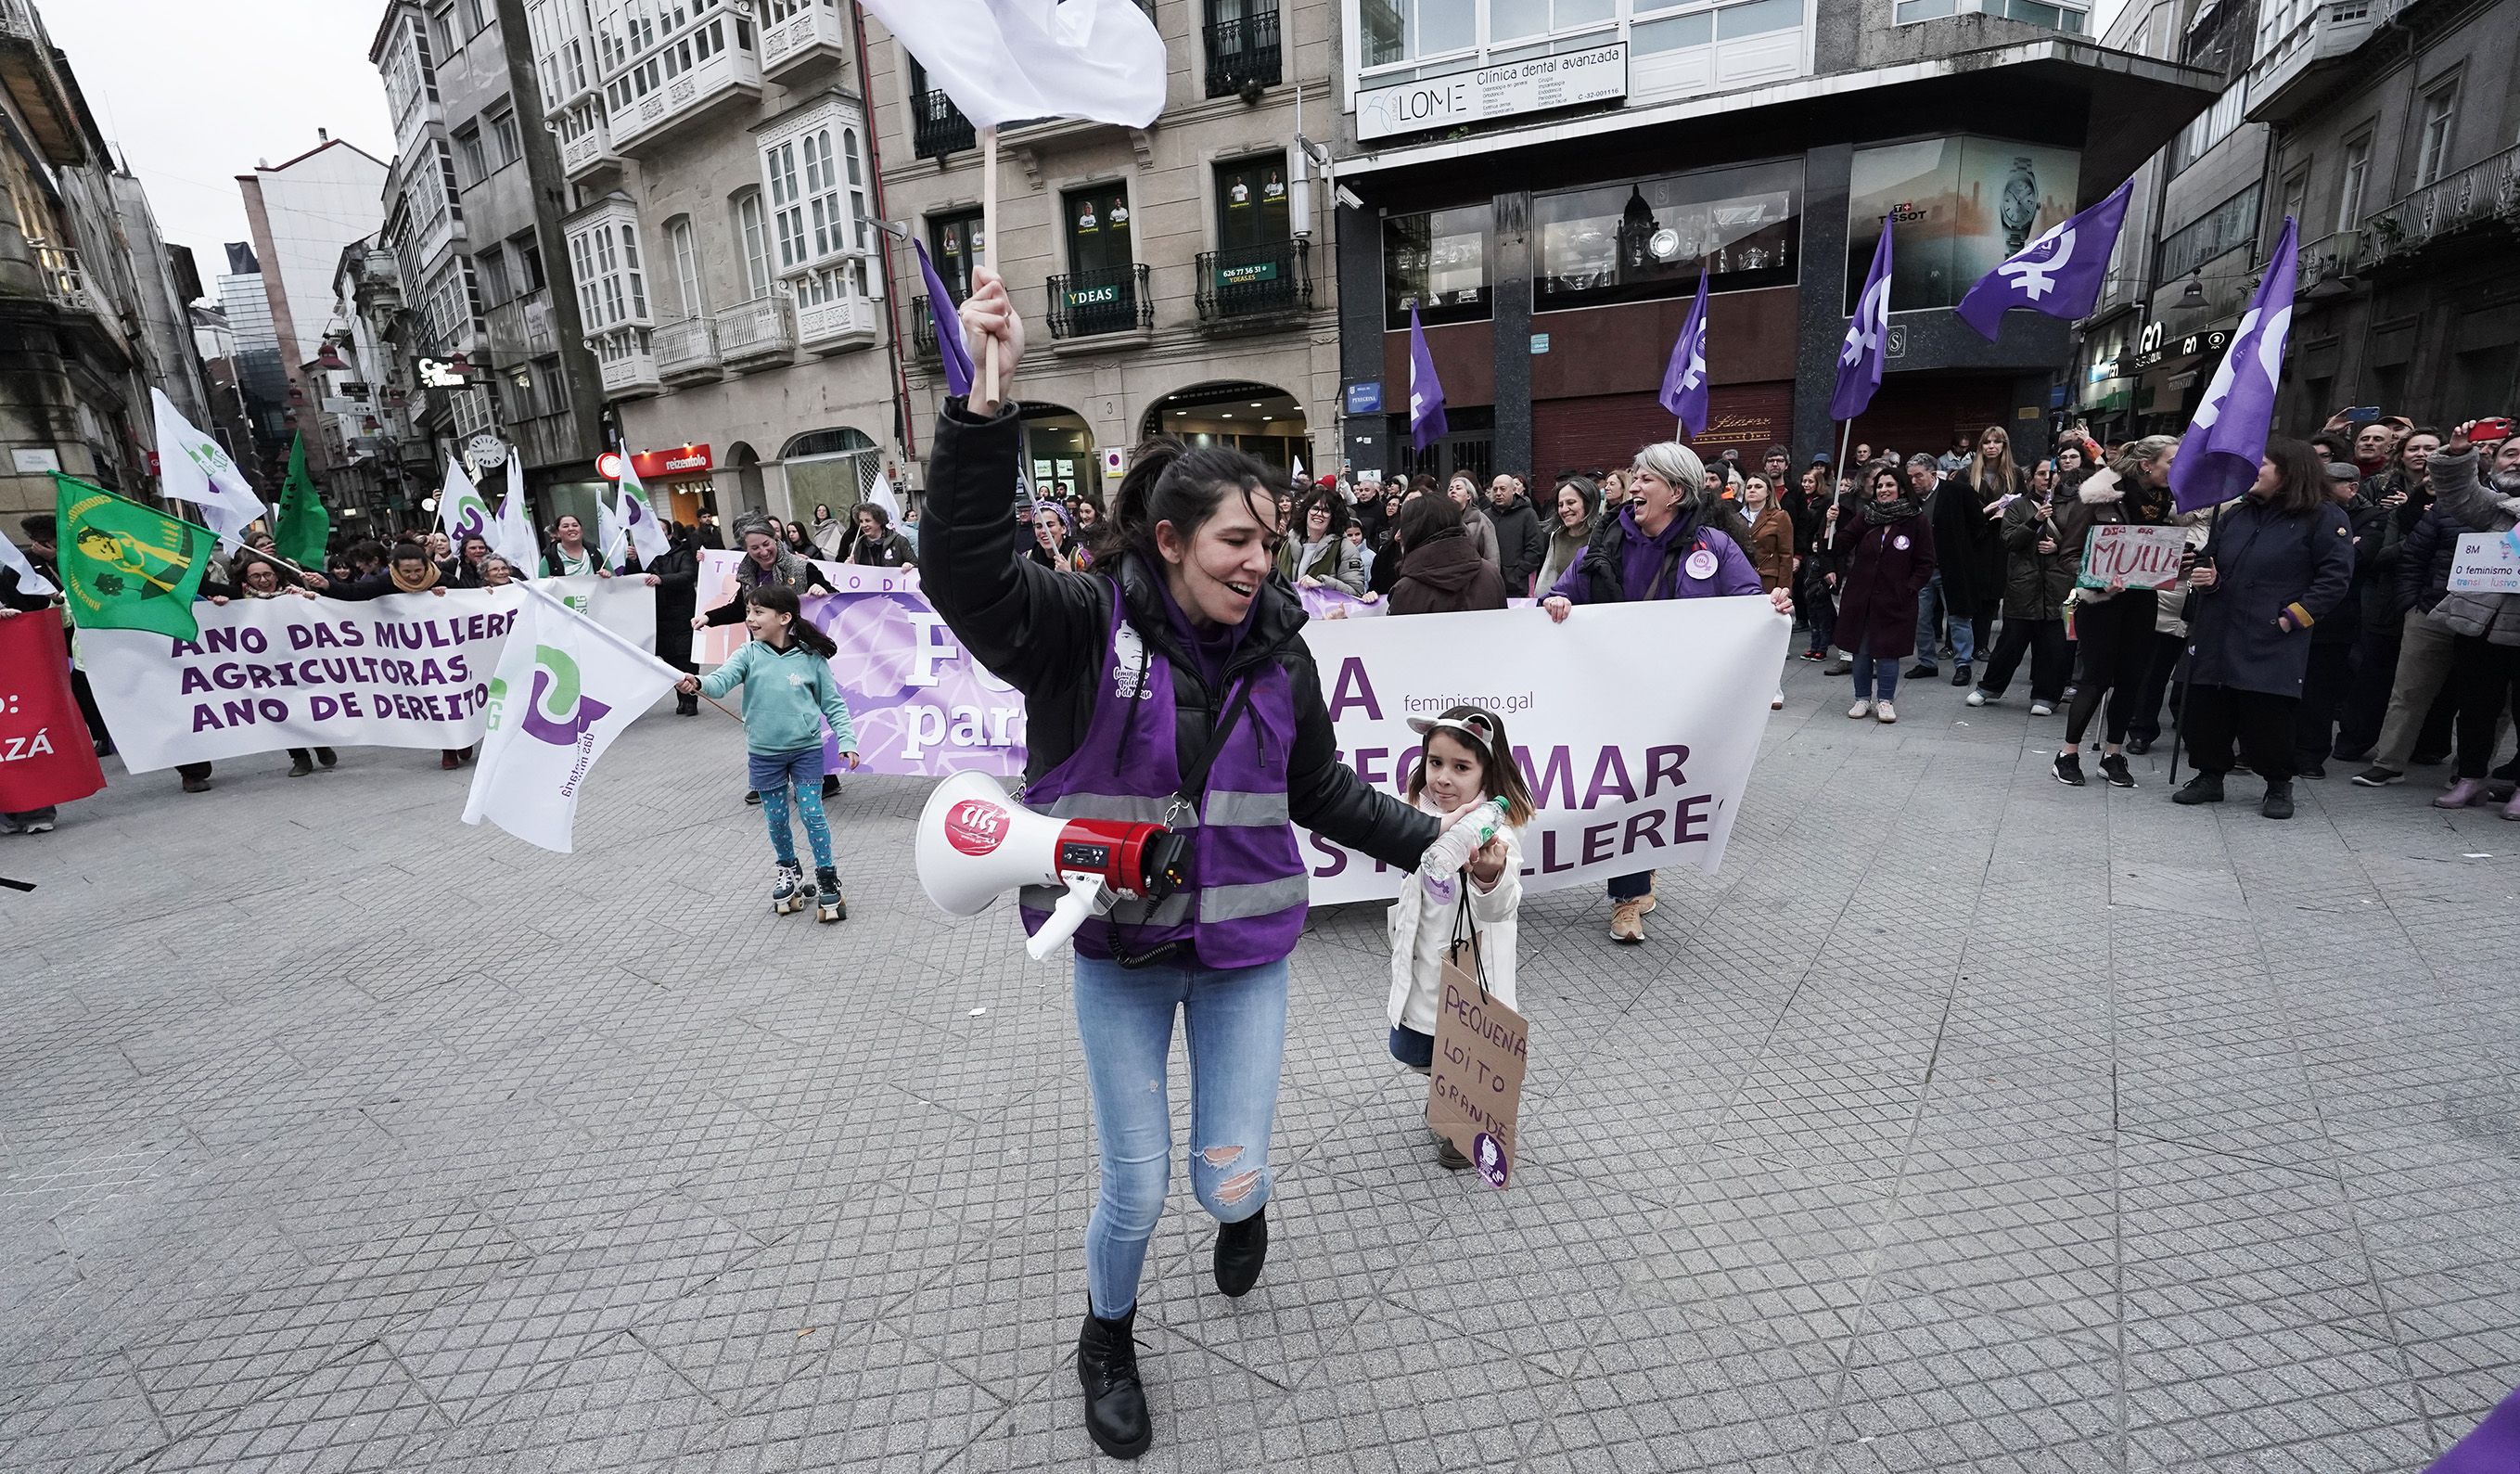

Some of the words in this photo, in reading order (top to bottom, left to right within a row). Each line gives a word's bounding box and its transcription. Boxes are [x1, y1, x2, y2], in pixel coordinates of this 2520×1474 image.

[1477, 68, 1517, 85] Clínica
[1522, 59, 1556, 77] dental
[1562, 49, 1619, 70] avanzada
[1399, 83, 1466, 121] LOME
[1878, 211, 1926, 224] TSSOT
[1245, 266, 1253, 275] 36
[1068, 288, 1113, 304] YDEAS
[1106, 402, 1113, 415] 3
[2465, 545, 2481, 555] 8M
[2466, 566, 2513, 575] feminismo
[288, 622, 365, 650] DAS
[181, 654, 472, 695] AGRICULTORAS,
[192, 698, 288, 733] ANO
[310, 692, 363, 722] DE
[373, 683, 488, 722] DEREITO
[1404, 691, 1533, 713] feminismo.gal
[902, 704, 1027, 761] par
[1435, 1074, 1508, 1146] GRANDE
